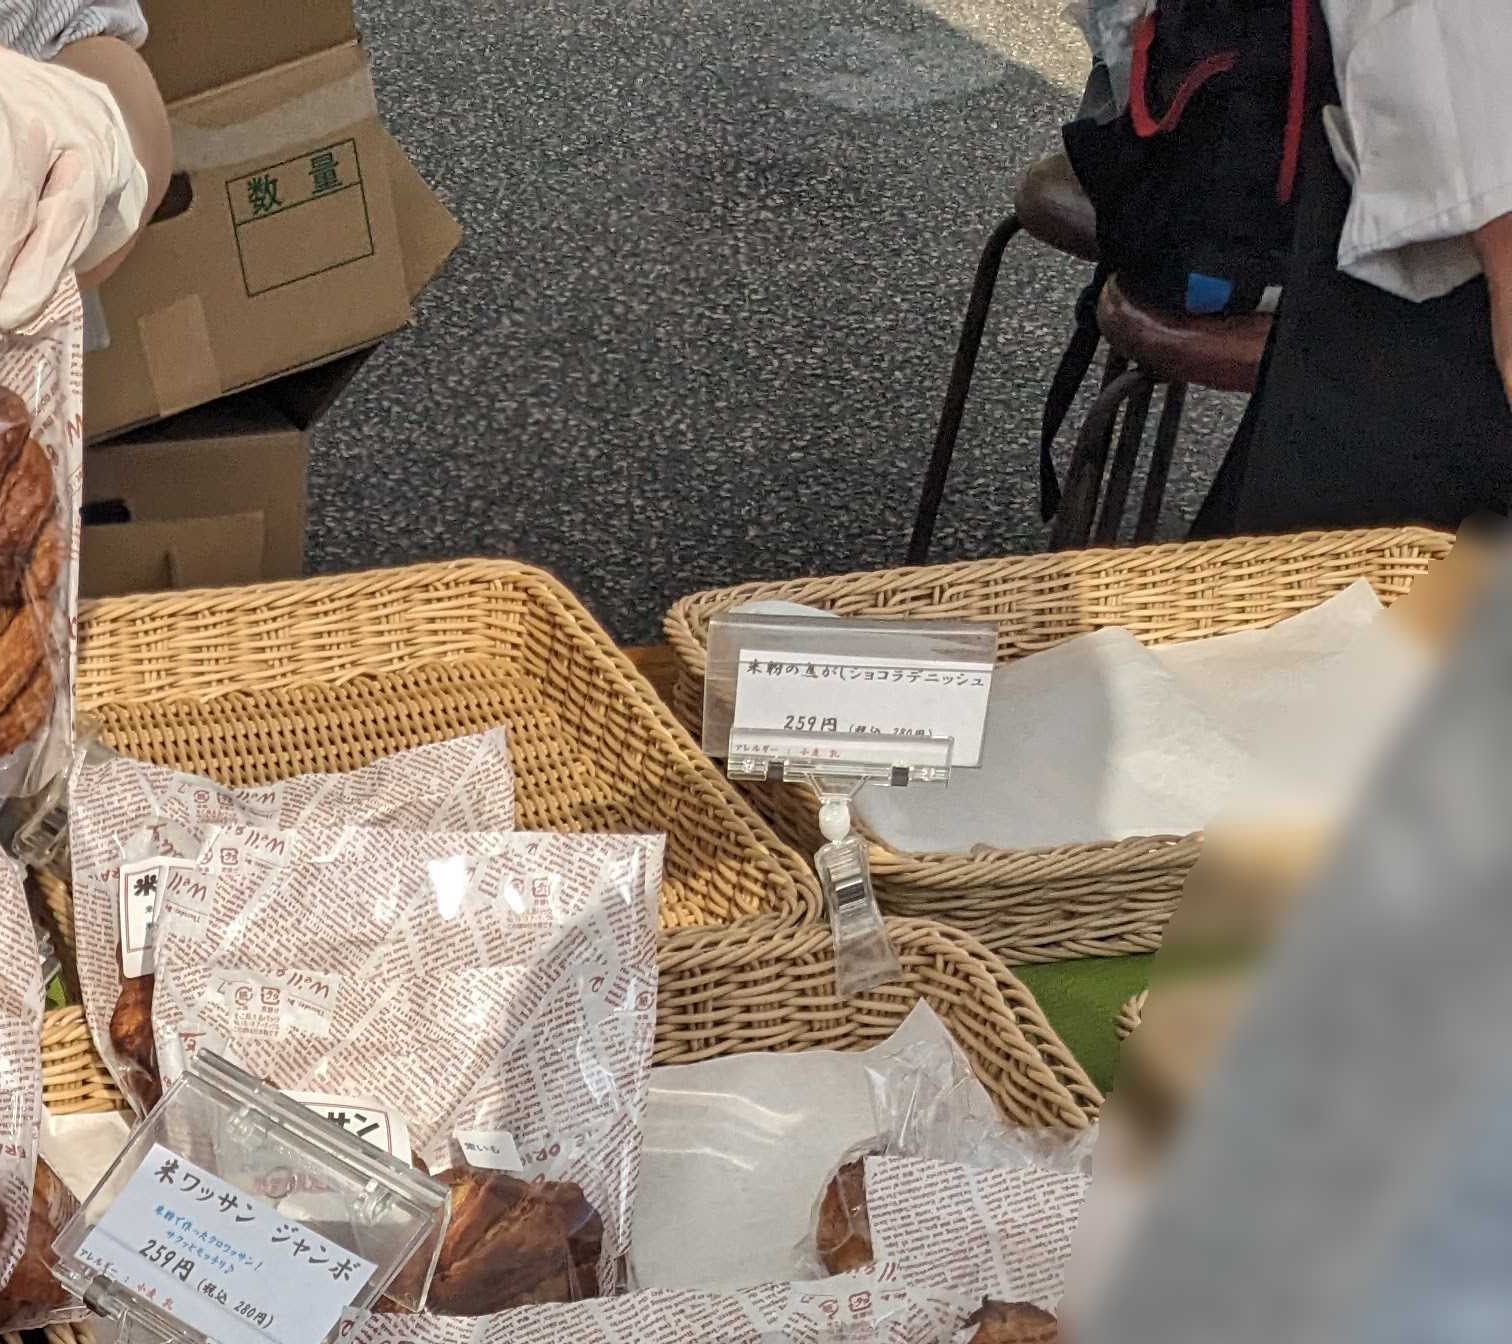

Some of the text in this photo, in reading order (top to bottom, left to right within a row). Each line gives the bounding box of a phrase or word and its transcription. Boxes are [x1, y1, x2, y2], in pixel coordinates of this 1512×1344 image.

[784, 715, 838, 732] 259円
[139, 1240, 194, 1282] 259円
[271, 1224, 361, 1281] ジャンボ
